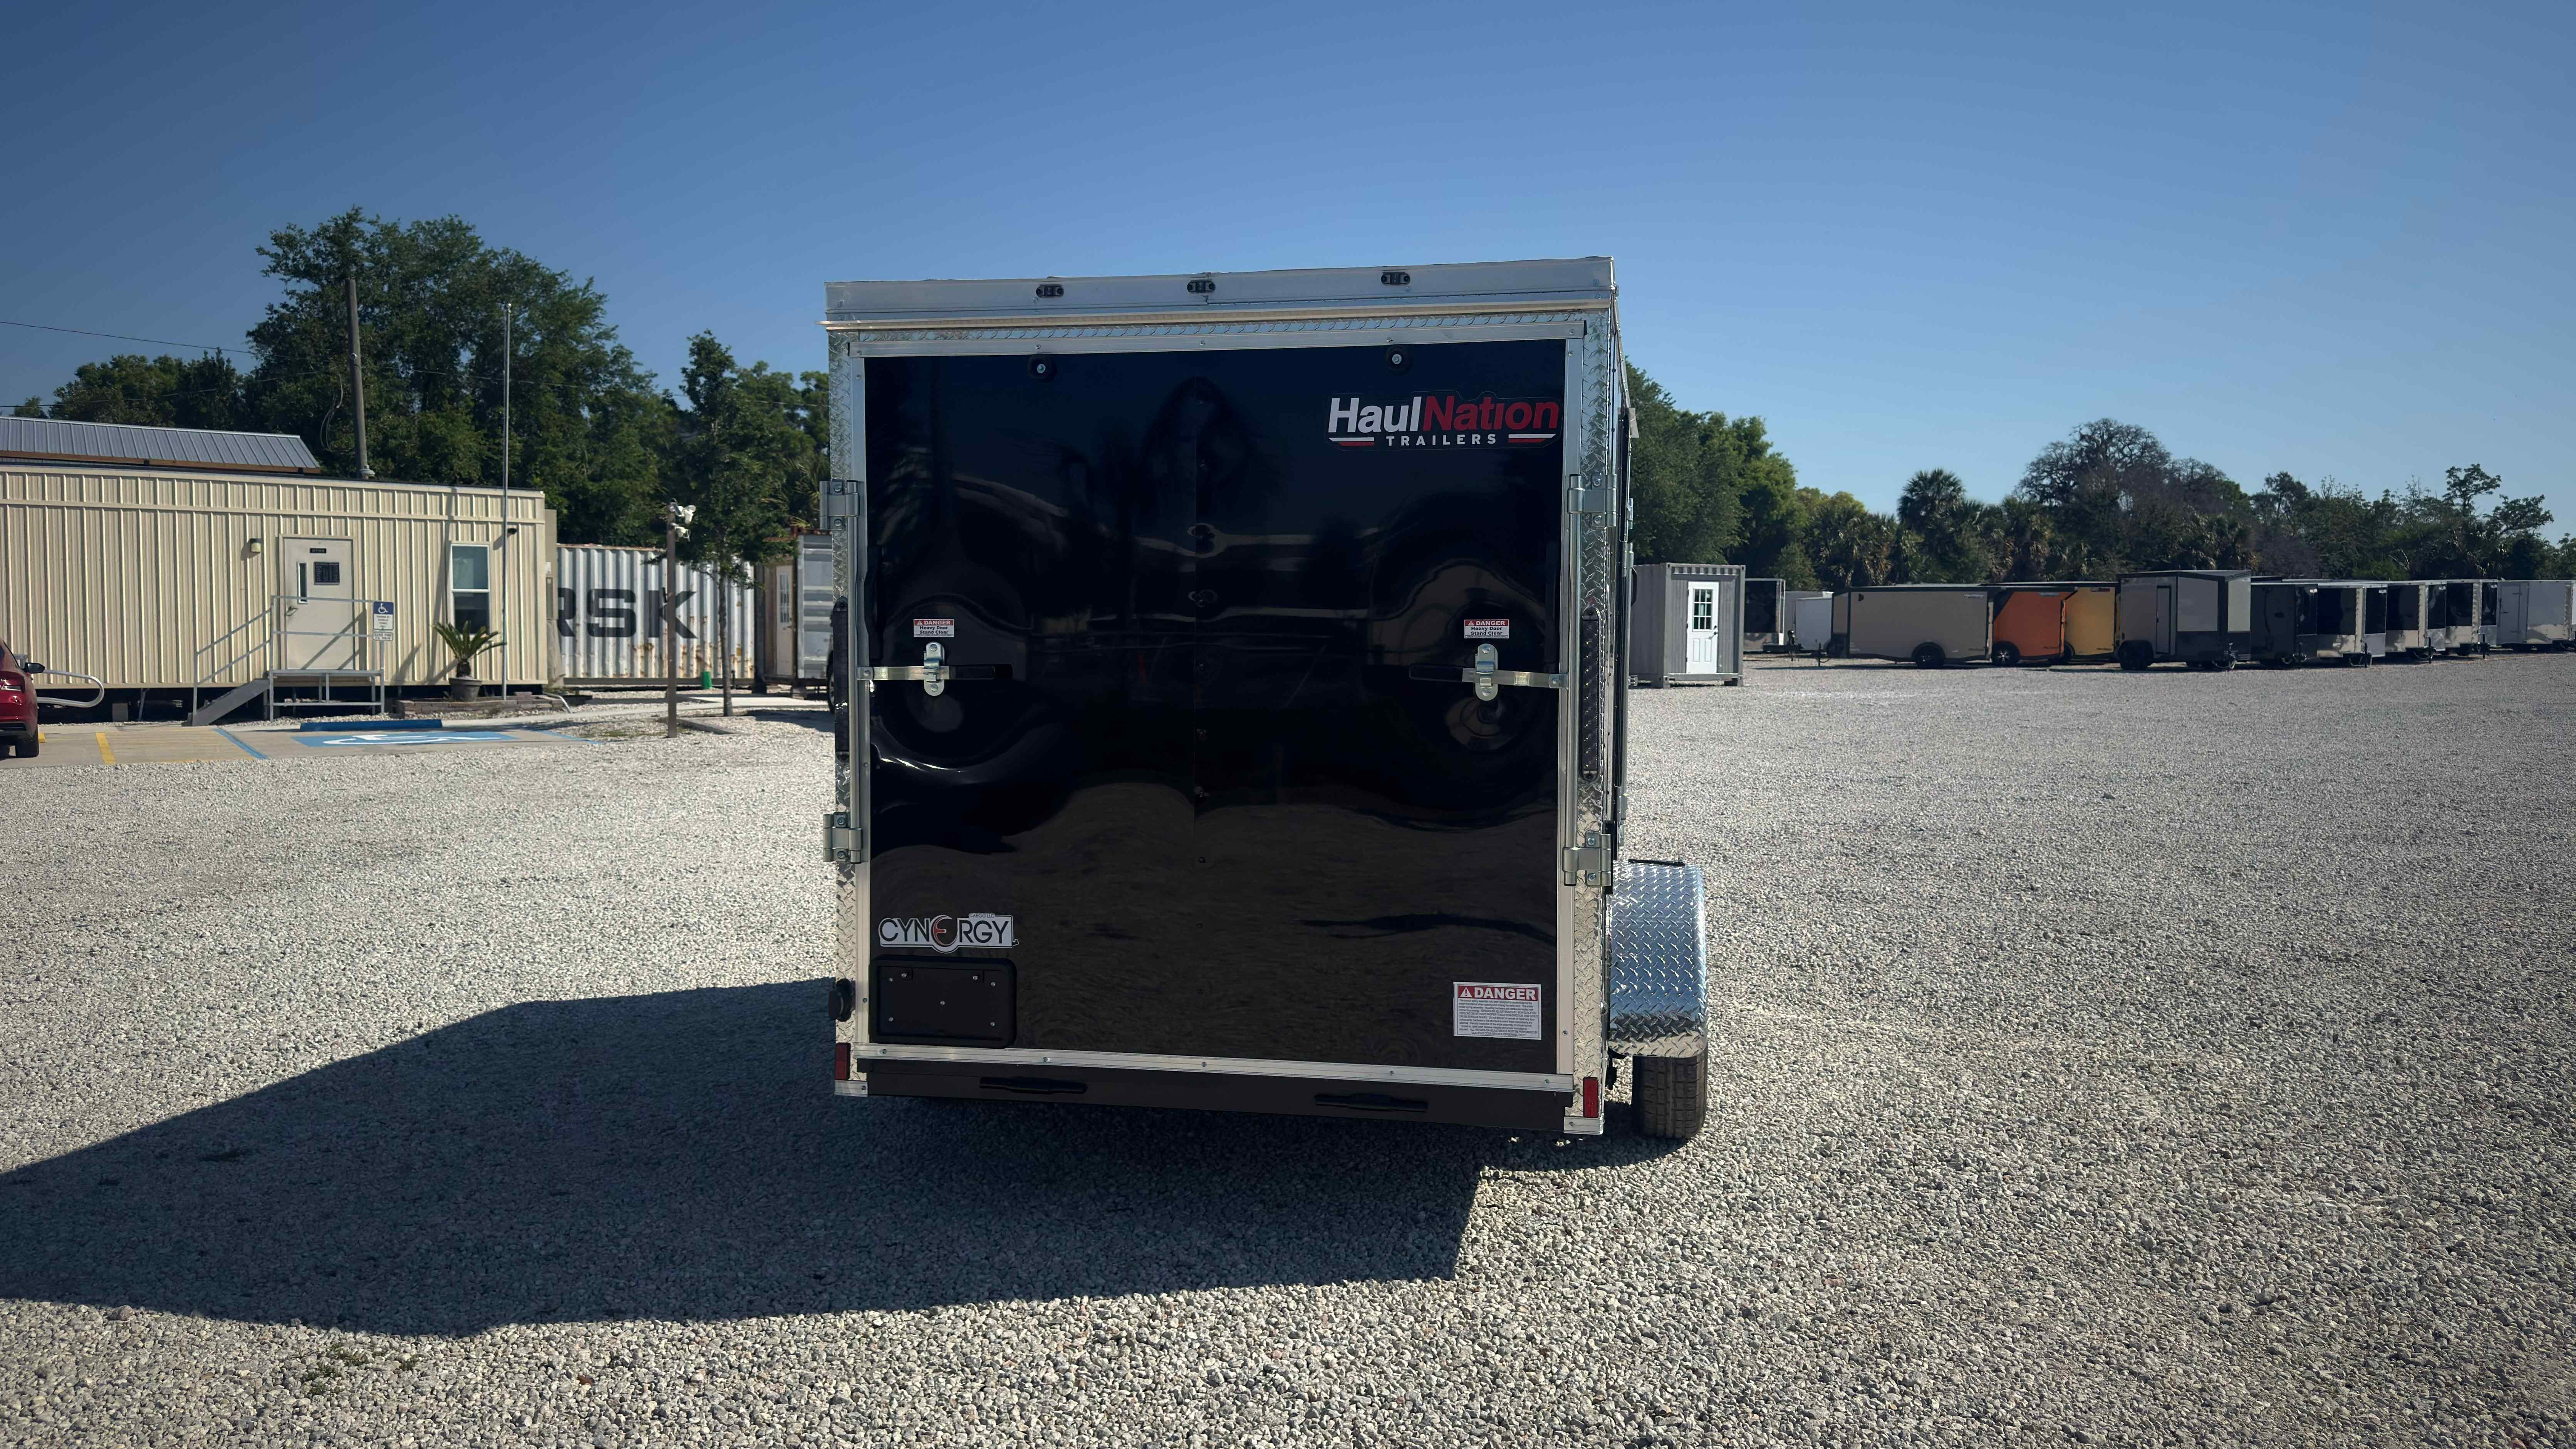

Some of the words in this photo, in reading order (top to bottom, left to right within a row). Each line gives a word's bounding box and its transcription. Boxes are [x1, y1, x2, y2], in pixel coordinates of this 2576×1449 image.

[1328, 396, 1559, 433] HaulNation
[1386, 434, 1496, 446] TRAILERS
[879, 915, 1010, 947] CYNERGY
[1474, 987, 1536, 1000] DANGER
